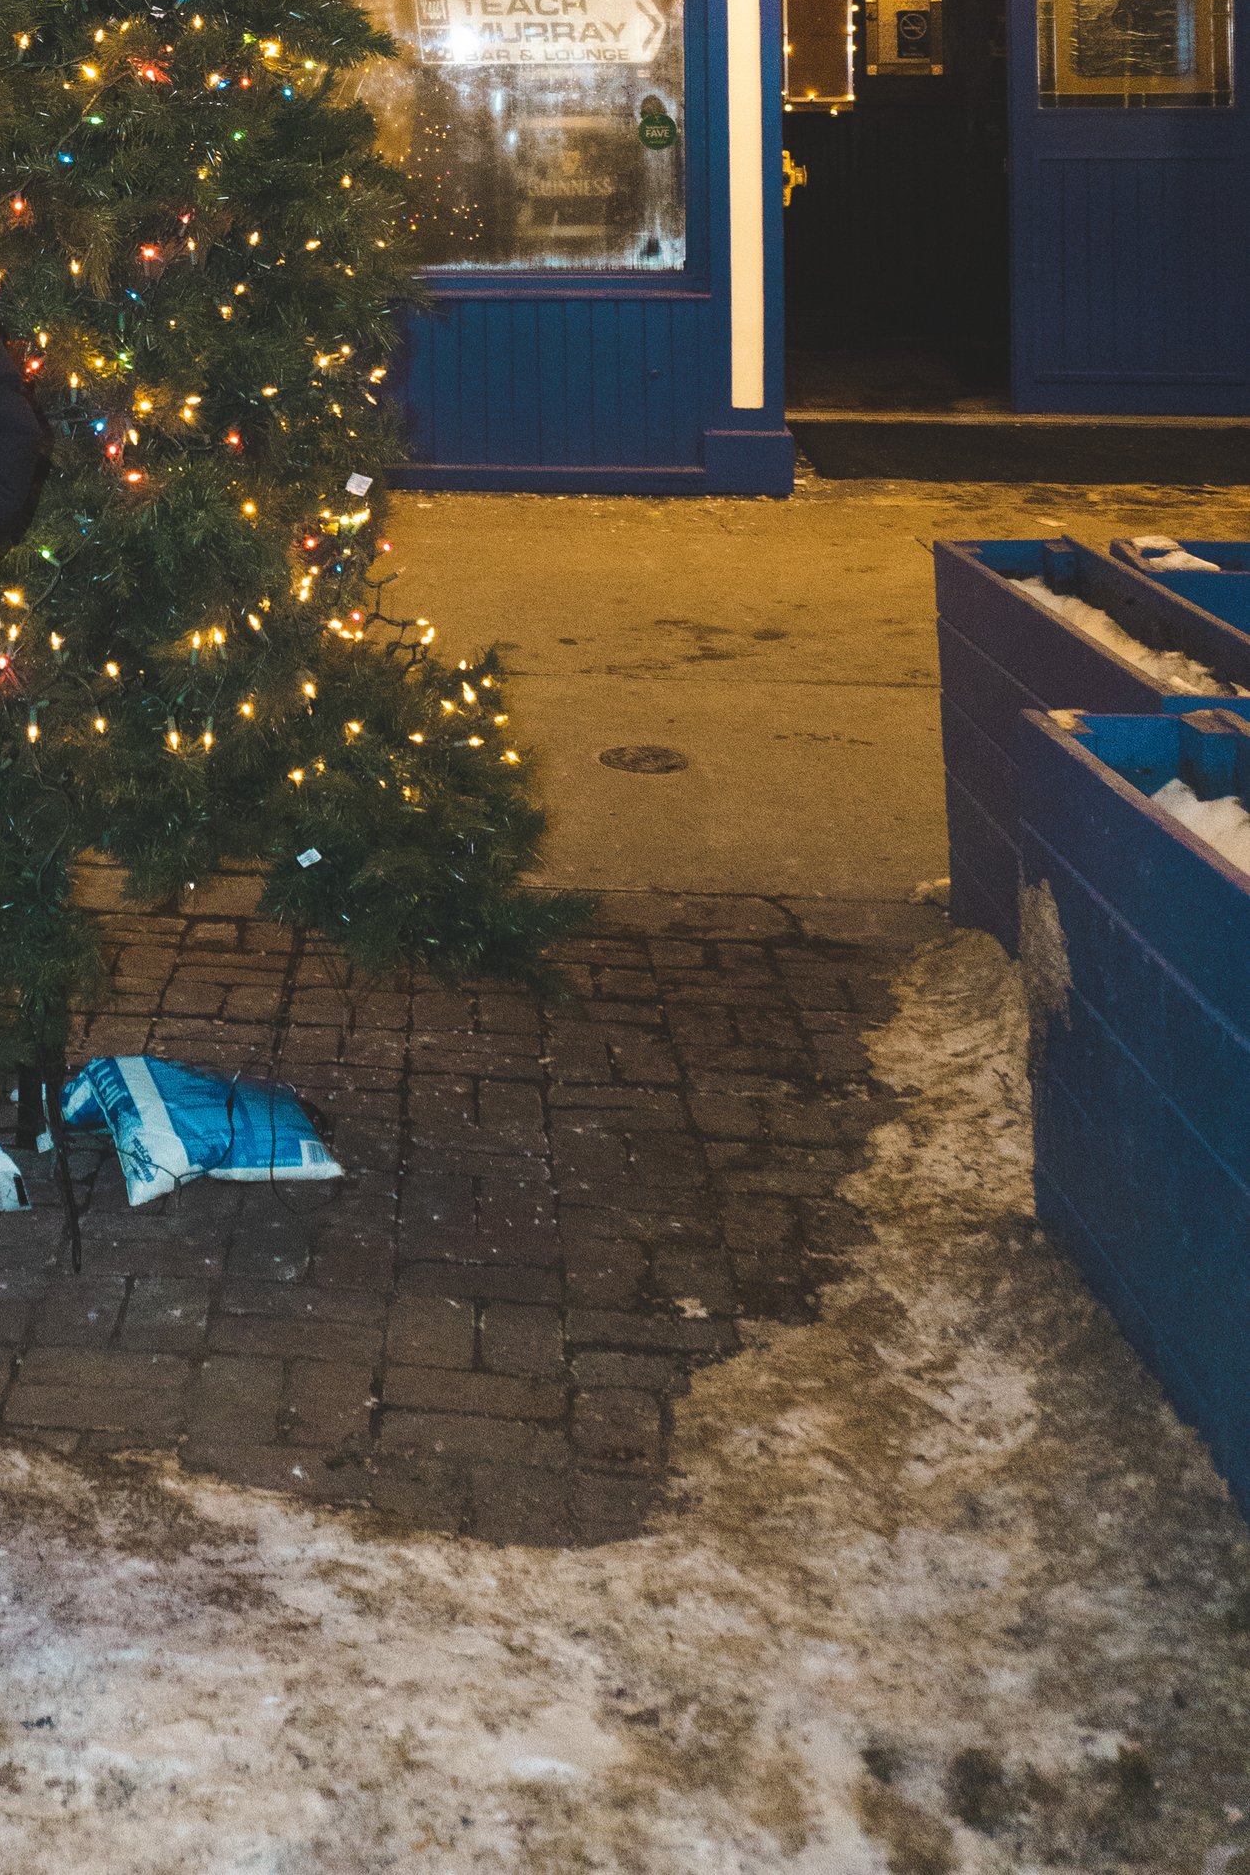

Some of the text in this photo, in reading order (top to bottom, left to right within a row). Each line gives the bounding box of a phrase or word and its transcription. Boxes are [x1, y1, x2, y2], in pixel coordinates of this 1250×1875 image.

[465, 48, 631, 62] BAR & LOUNGE
[645, 128, 671, 138] FAVE
